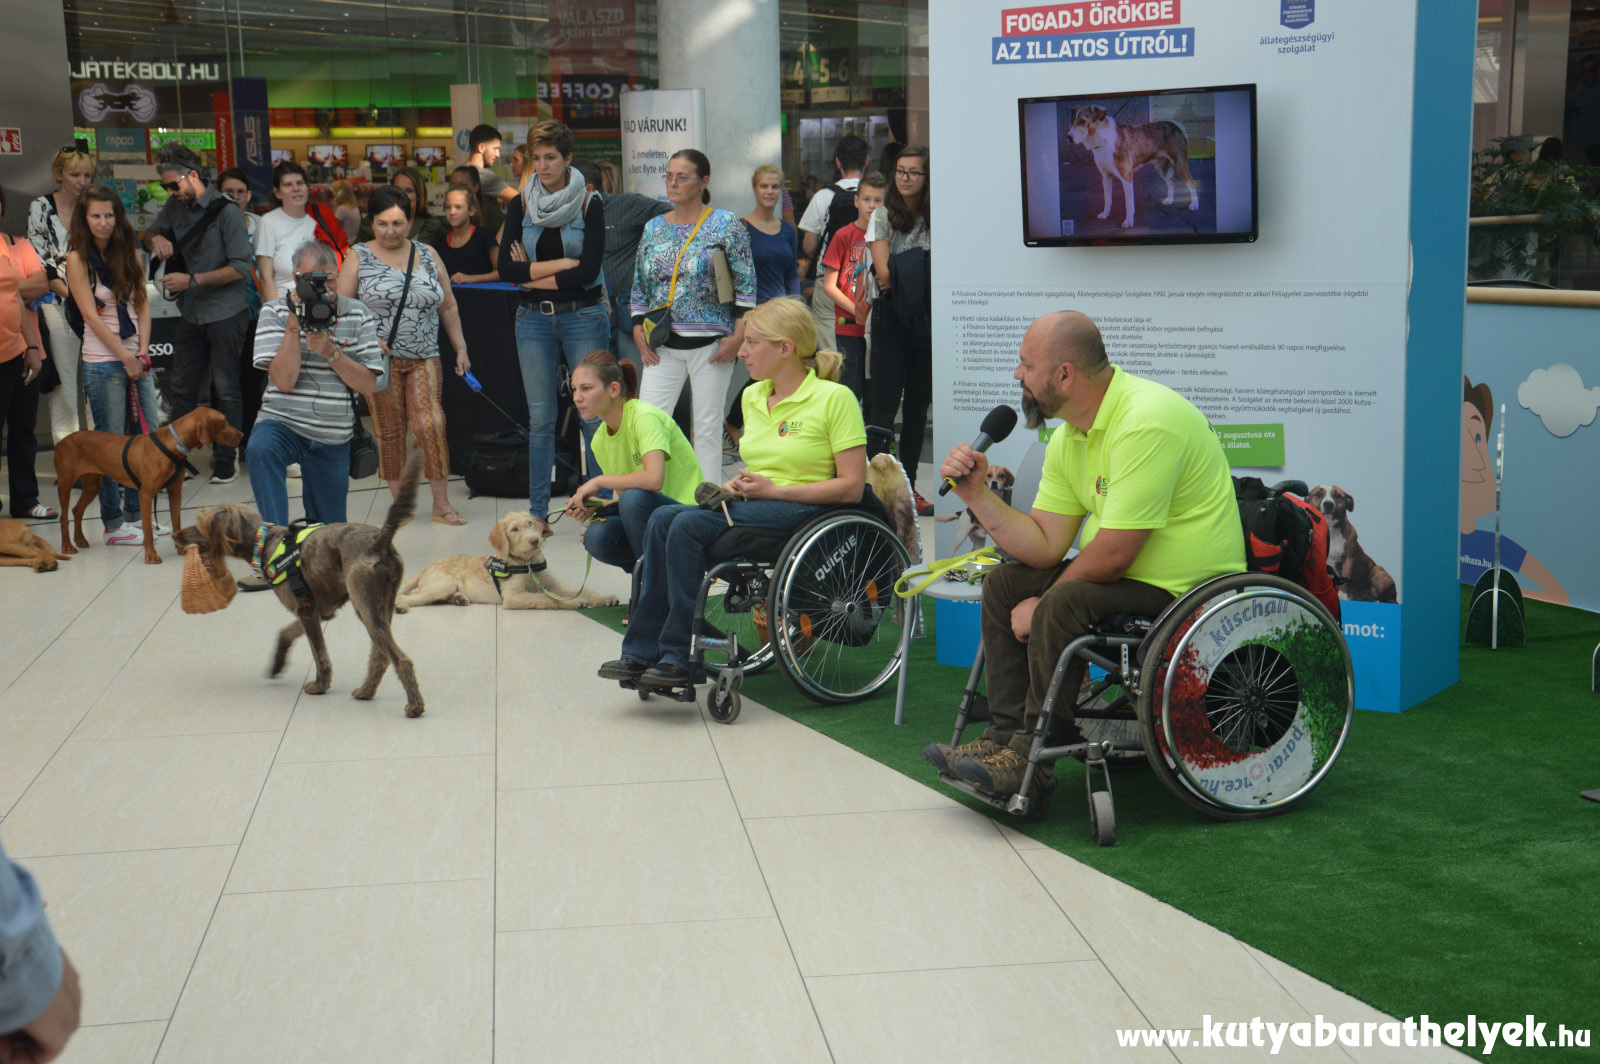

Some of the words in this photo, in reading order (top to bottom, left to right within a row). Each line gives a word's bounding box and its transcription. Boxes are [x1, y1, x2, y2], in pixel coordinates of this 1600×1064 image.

[556, 5, 624, 26] VÁLASZD
[1006, 8, 1084, 34] FOGADJ
[1089, 0, 1174, 25] ÖRÖKBE
[996, 42, 1022, 60] AZ
[1026, 38, 1109, 59] ILLATOS
[1114, 30, 1188, 56] ÚTRÓL!
[1260, 32, 1335, 46] állategészségügyi
[1278, 44, 1316, 54] szolgálat
[819, 58, 830, 83] 5
[638, 116, 687, 132] VÁRUNK!
[188, 136, 204, 146] 360
[244, 116, 258, 166] ASUS
[637, 150, 669, 160] emeleten,
[632, 164, 642, 174] Best
[643, 164, 657, 176] Byte
[1224, 432, 1262, 440] augusztusa
[814, 534, 858, 582] QUICKIE
[1209, 598, 1289, 648] küschall
[1344, 623, 1385, 638] mot:
